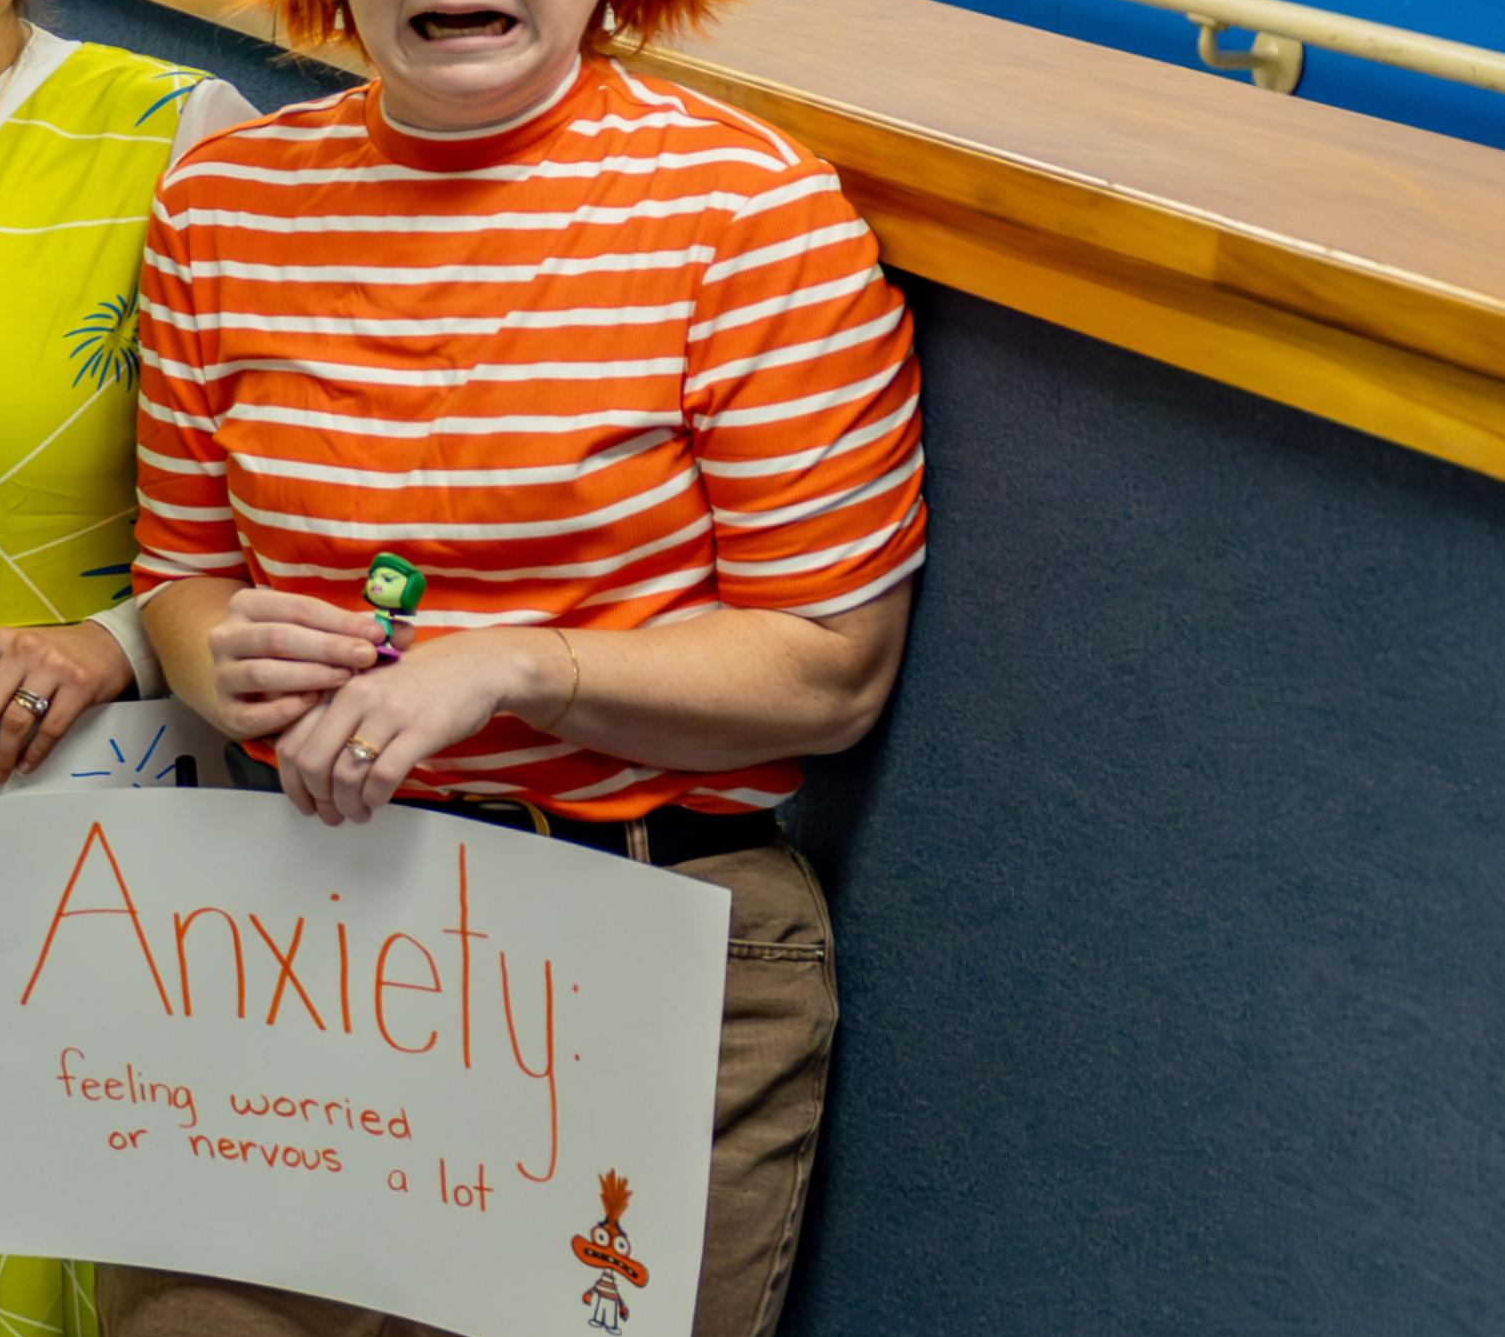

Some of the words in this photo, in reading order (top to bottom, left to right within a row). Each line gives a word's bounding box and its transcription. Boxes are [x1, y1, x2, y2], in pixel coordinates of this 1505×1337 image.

[56, 1047, 199, 1128] feeling
[229, 1093, 413, 1140] worried
[107, 1128, 149, 1151] or
[187, 1133, 343, 1173] nervous
[387, 1169, 409, 1194] a
[439, 1157, 495, 1212] lot
